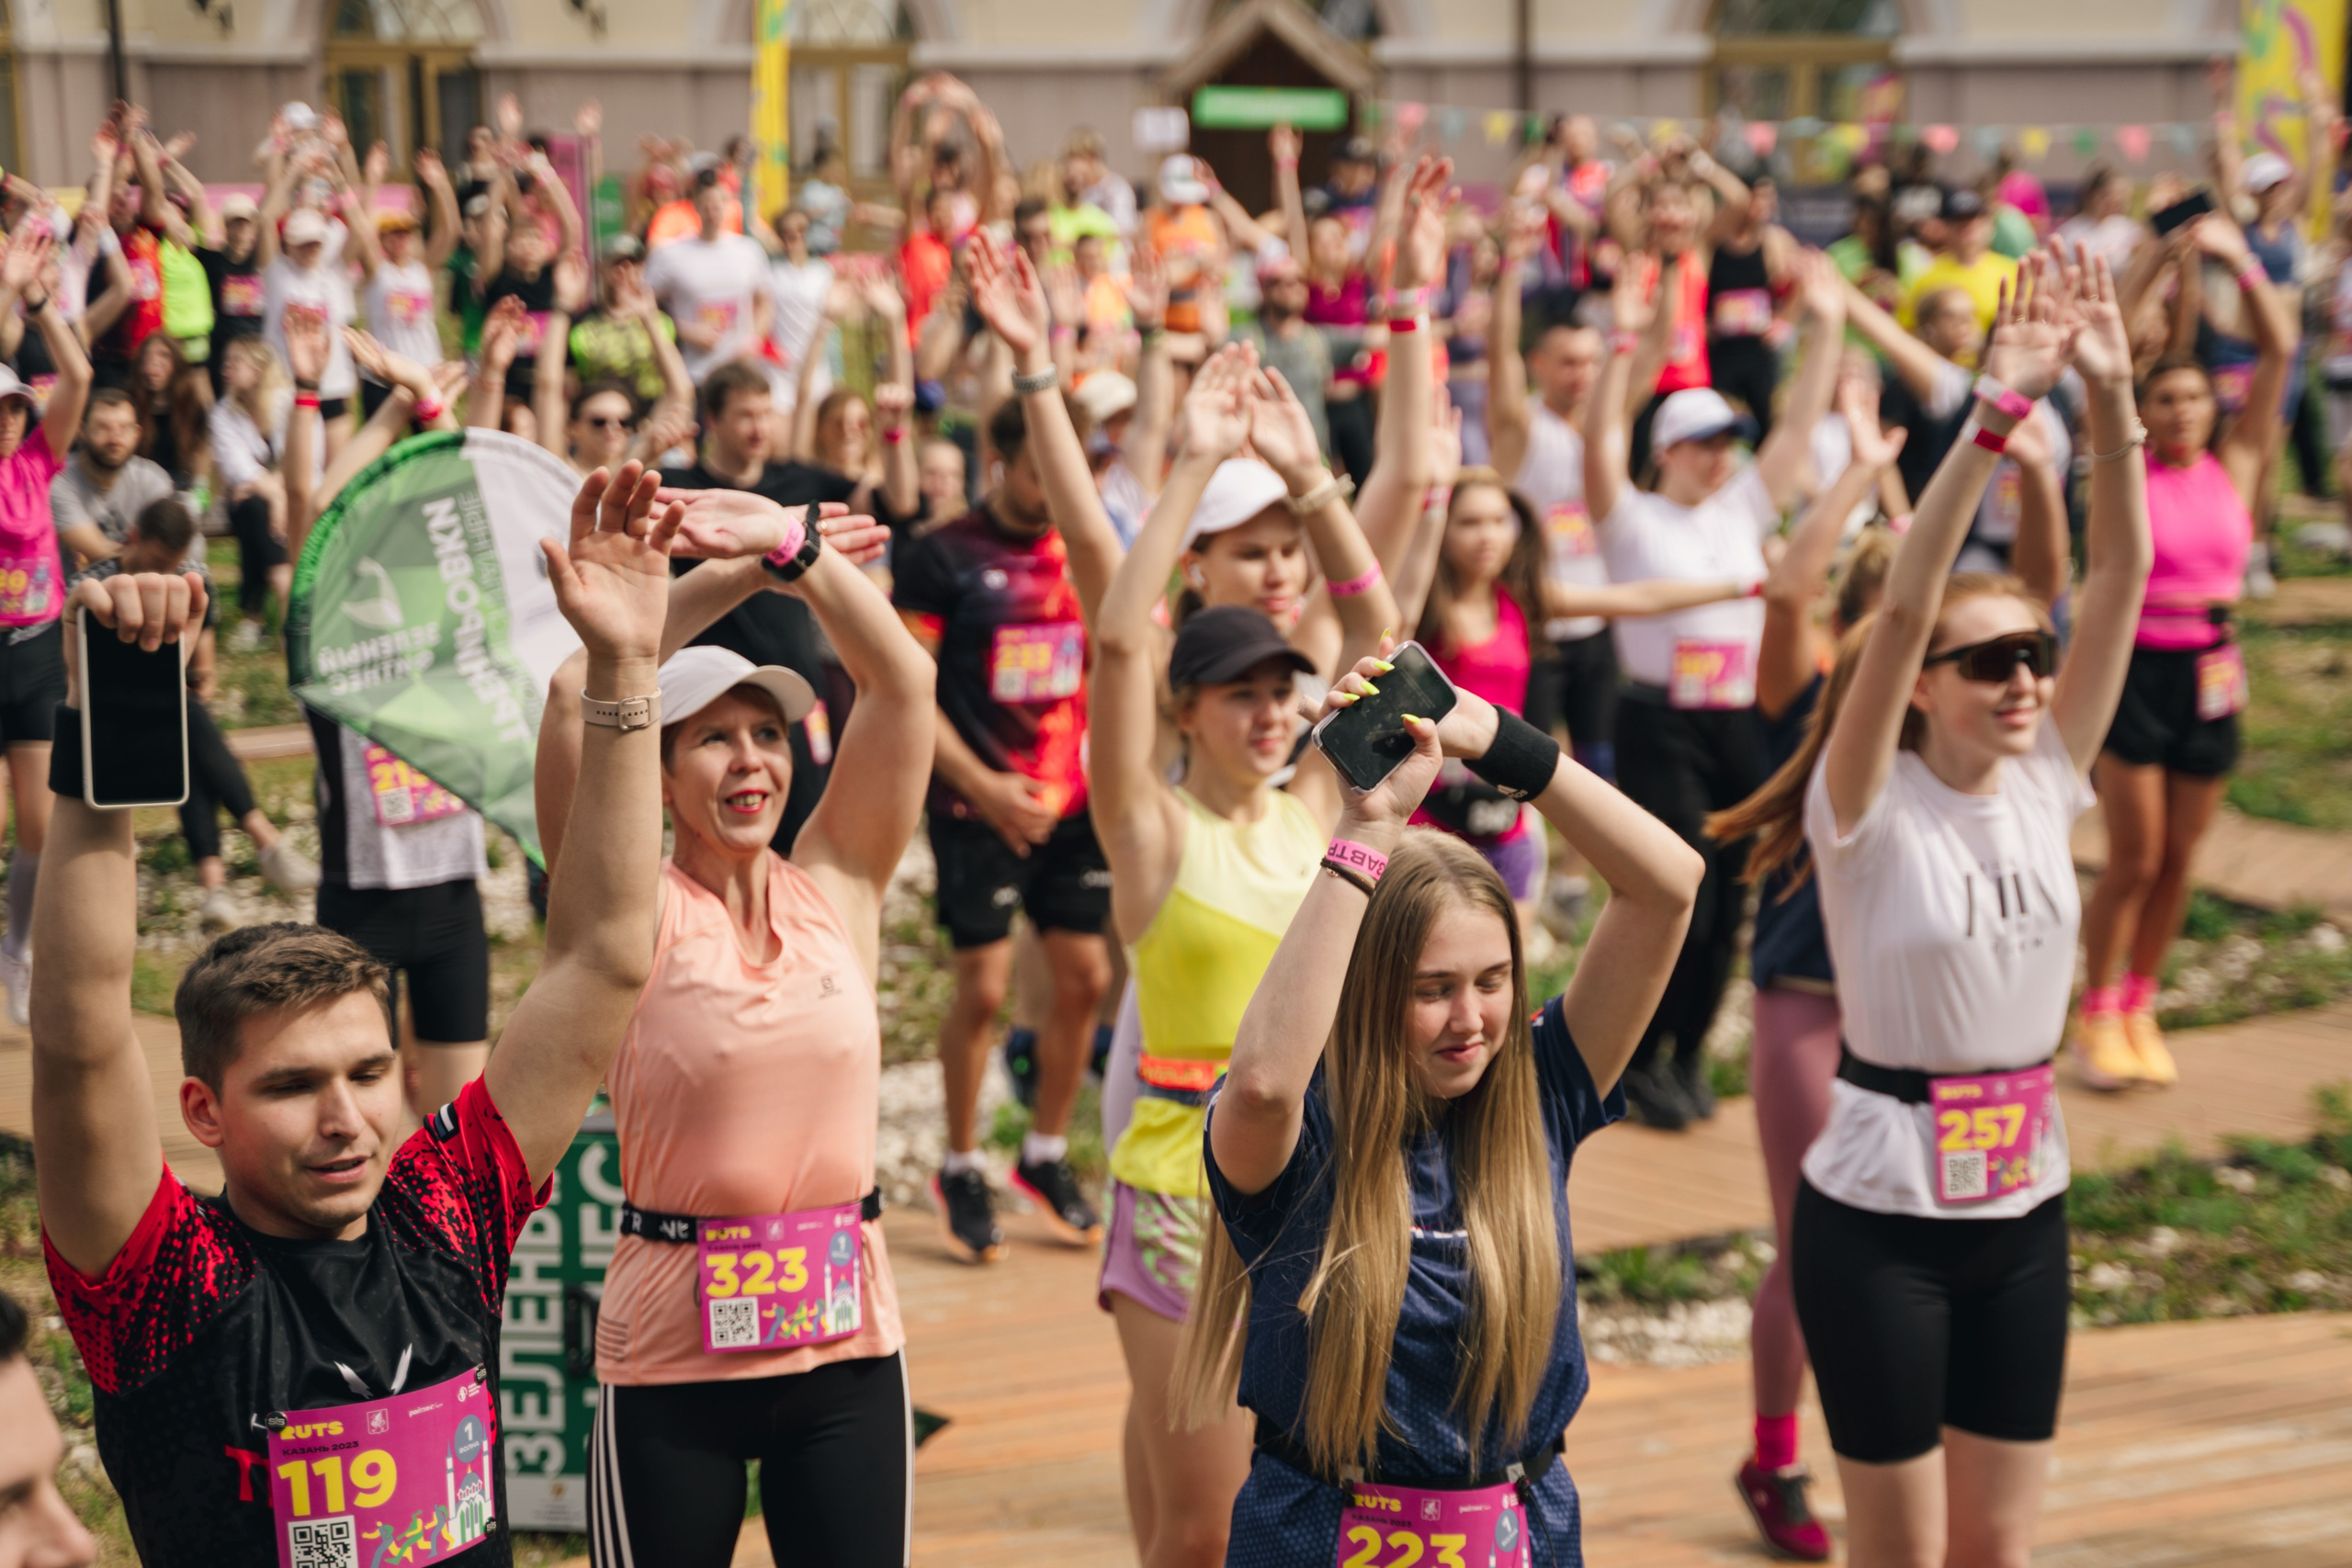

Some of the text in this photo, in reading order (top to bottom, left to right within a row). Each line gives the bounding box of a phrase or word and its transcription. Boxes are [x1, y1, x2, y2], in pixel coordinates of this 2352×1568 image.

[1938, 1102, 2026, 1151] 257
[706, 1247, 808, 1298] 323
[280, 1421, 345, 1440] RUTS
[464, 1422, 473, 1441] 1
[282, 1440, 359, 1456] КАЗАНЬ 2023
[458, 1441, 481, 1454] ВОЛНА
[277, 1450, 397, 1517] 119
[1355, 1494, 1402, 1513] RUTS
[1343, 1526, 1467, 1568] 223
